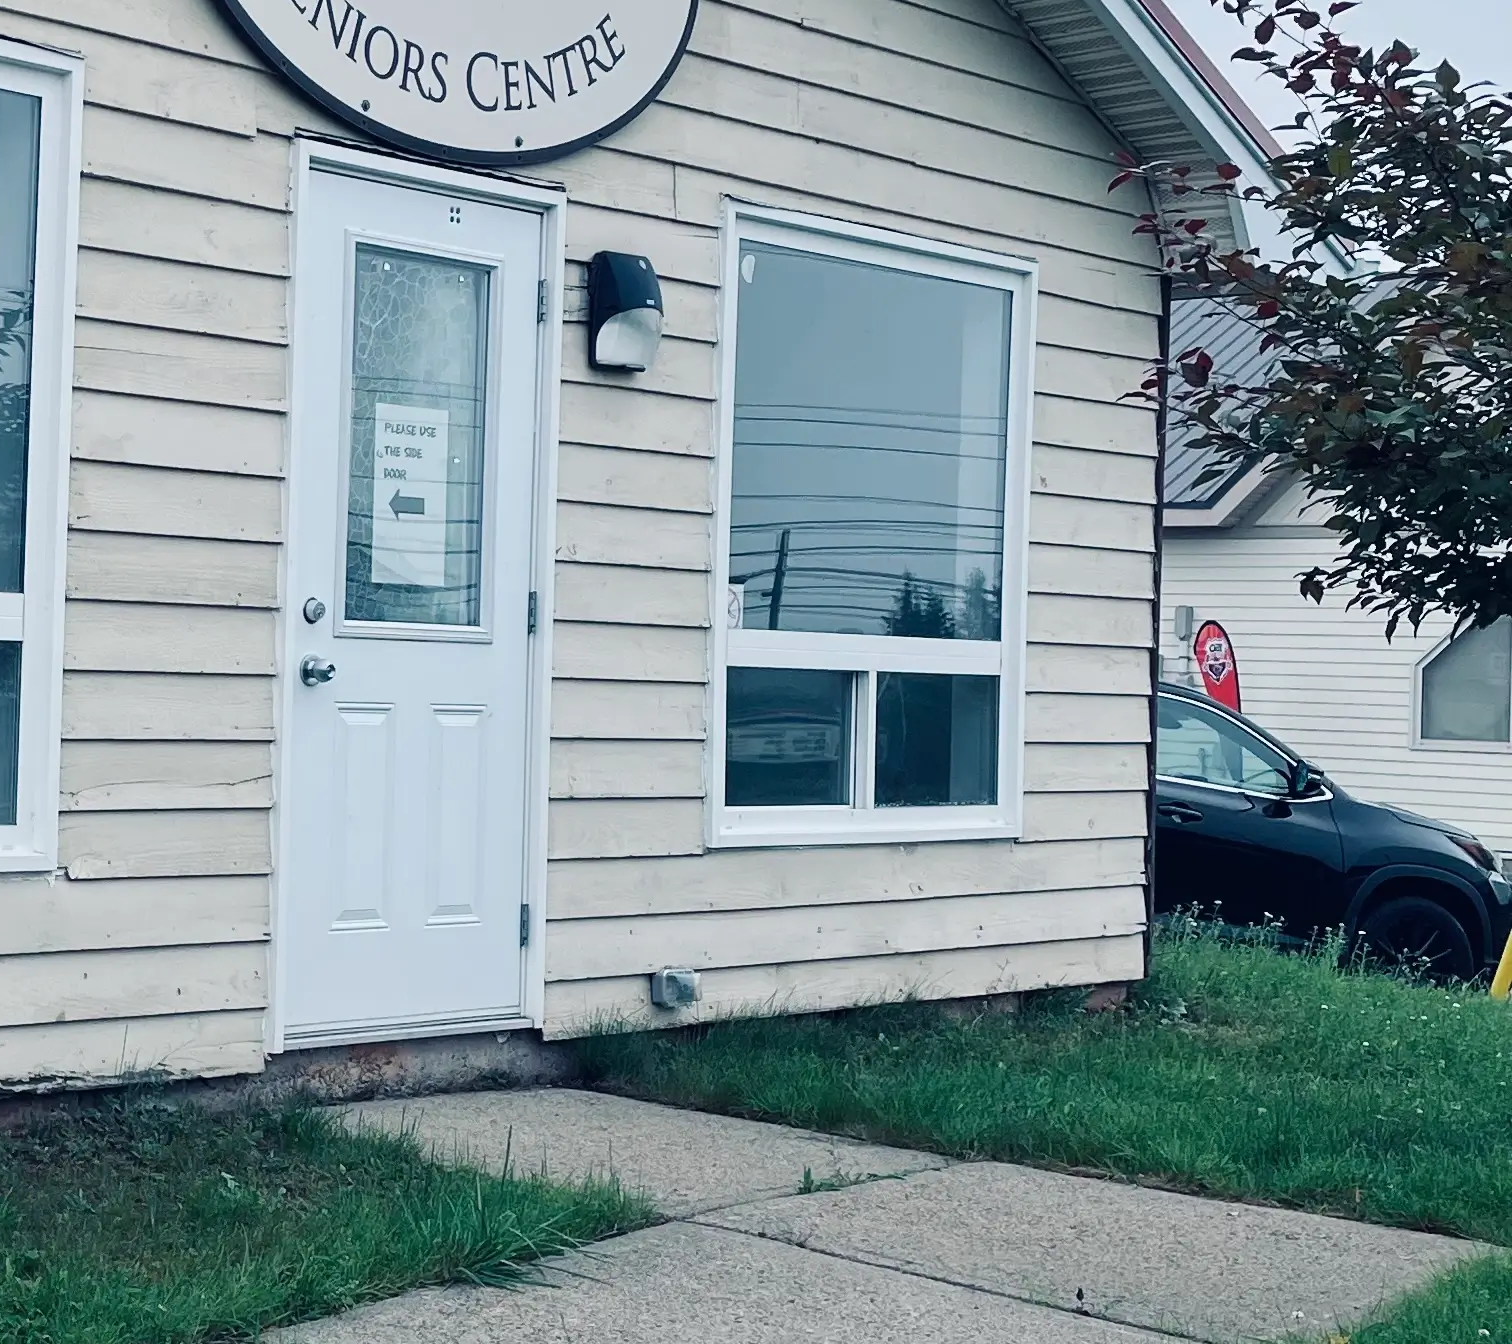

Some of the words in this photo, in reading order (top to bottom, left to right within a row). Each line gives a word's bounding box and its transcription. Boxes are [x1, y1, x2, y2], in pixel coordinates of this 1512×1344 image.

[466, 14, 626, 112] CENTRE
[384, 422, 417, 436] PLEASE
[419, 425, 437, 438] USE
[384, 445, 401, 457] THE
[404, 447, 423, 459] SIDE
[383, 467, 407, 481] DOOR
